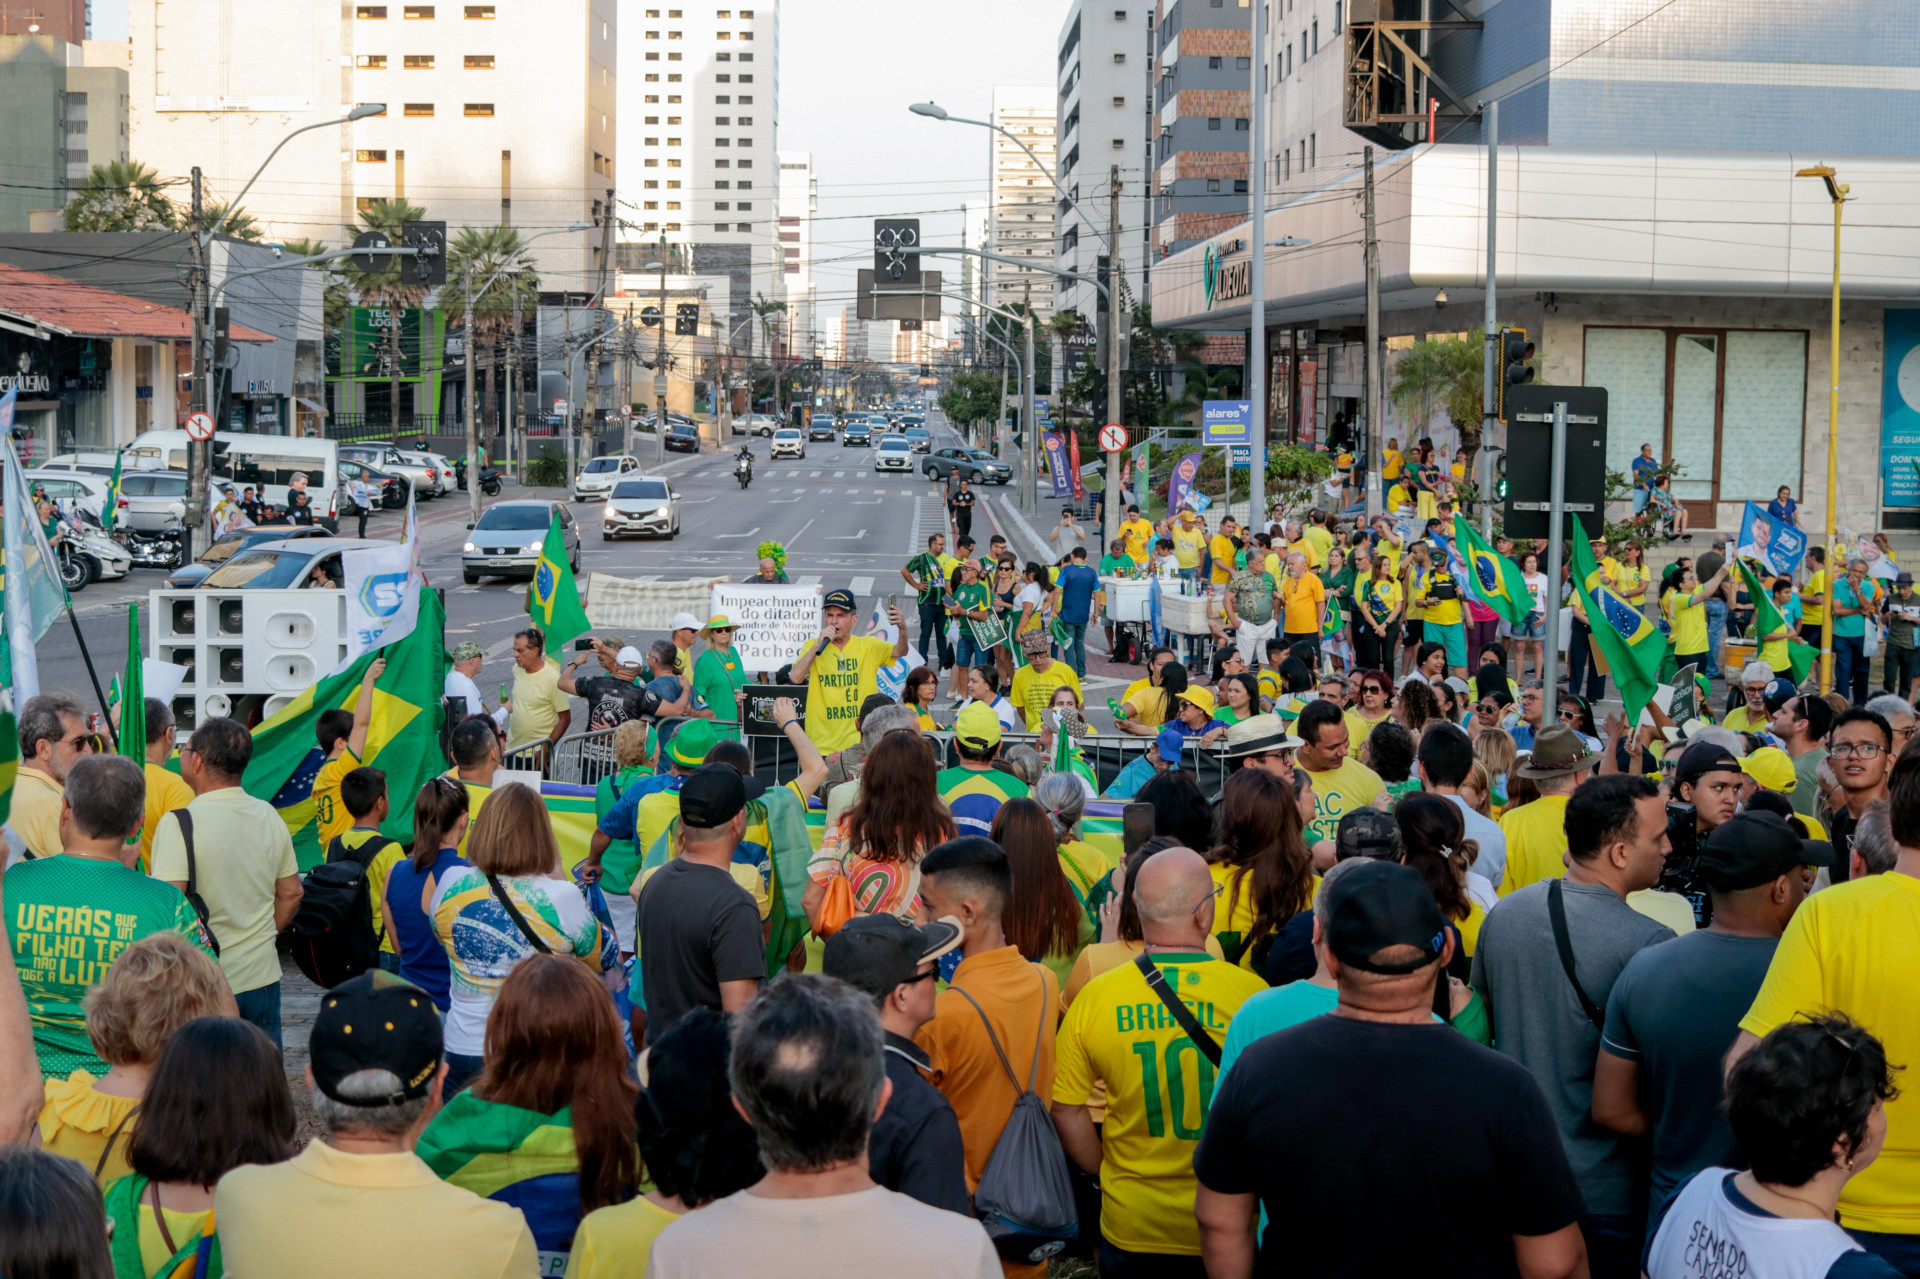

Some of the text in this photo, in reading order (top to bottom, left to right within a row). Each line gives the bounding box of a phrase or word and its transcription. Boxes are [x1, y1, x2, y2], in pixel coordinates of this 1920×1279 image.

[368, 309, 406, 318] TECO
[368, 318, 402, 327] LOGA
[1206, 407, 1240, 418] alares
[1893, 435, 1920, 444] SEGU
[1777, 532, 1797, 550] 22
[720, 594, 818, 609] Impeachment
[741, 607, 818, 620] do ditador
[771, 621, 780, 629] de
[782, 621, 818, 630] Moraes
[846, 688, 859, 703] É O
[826, 706, 861, 720] BRASIL
[17, 903, 112, 938] VERÁS
[17, 932, 86, 960] FILHO
[33, 956, 57, 971] NÃO
[16, 967, 44, 983] FOGE
[59, 958, 113, 986] LUT
[1116, 1001, 1225, 1033] BRAIL
[1132, 1036, 1216, 1141] 10
[1689, 1220, 1747, 1276] SENADO
